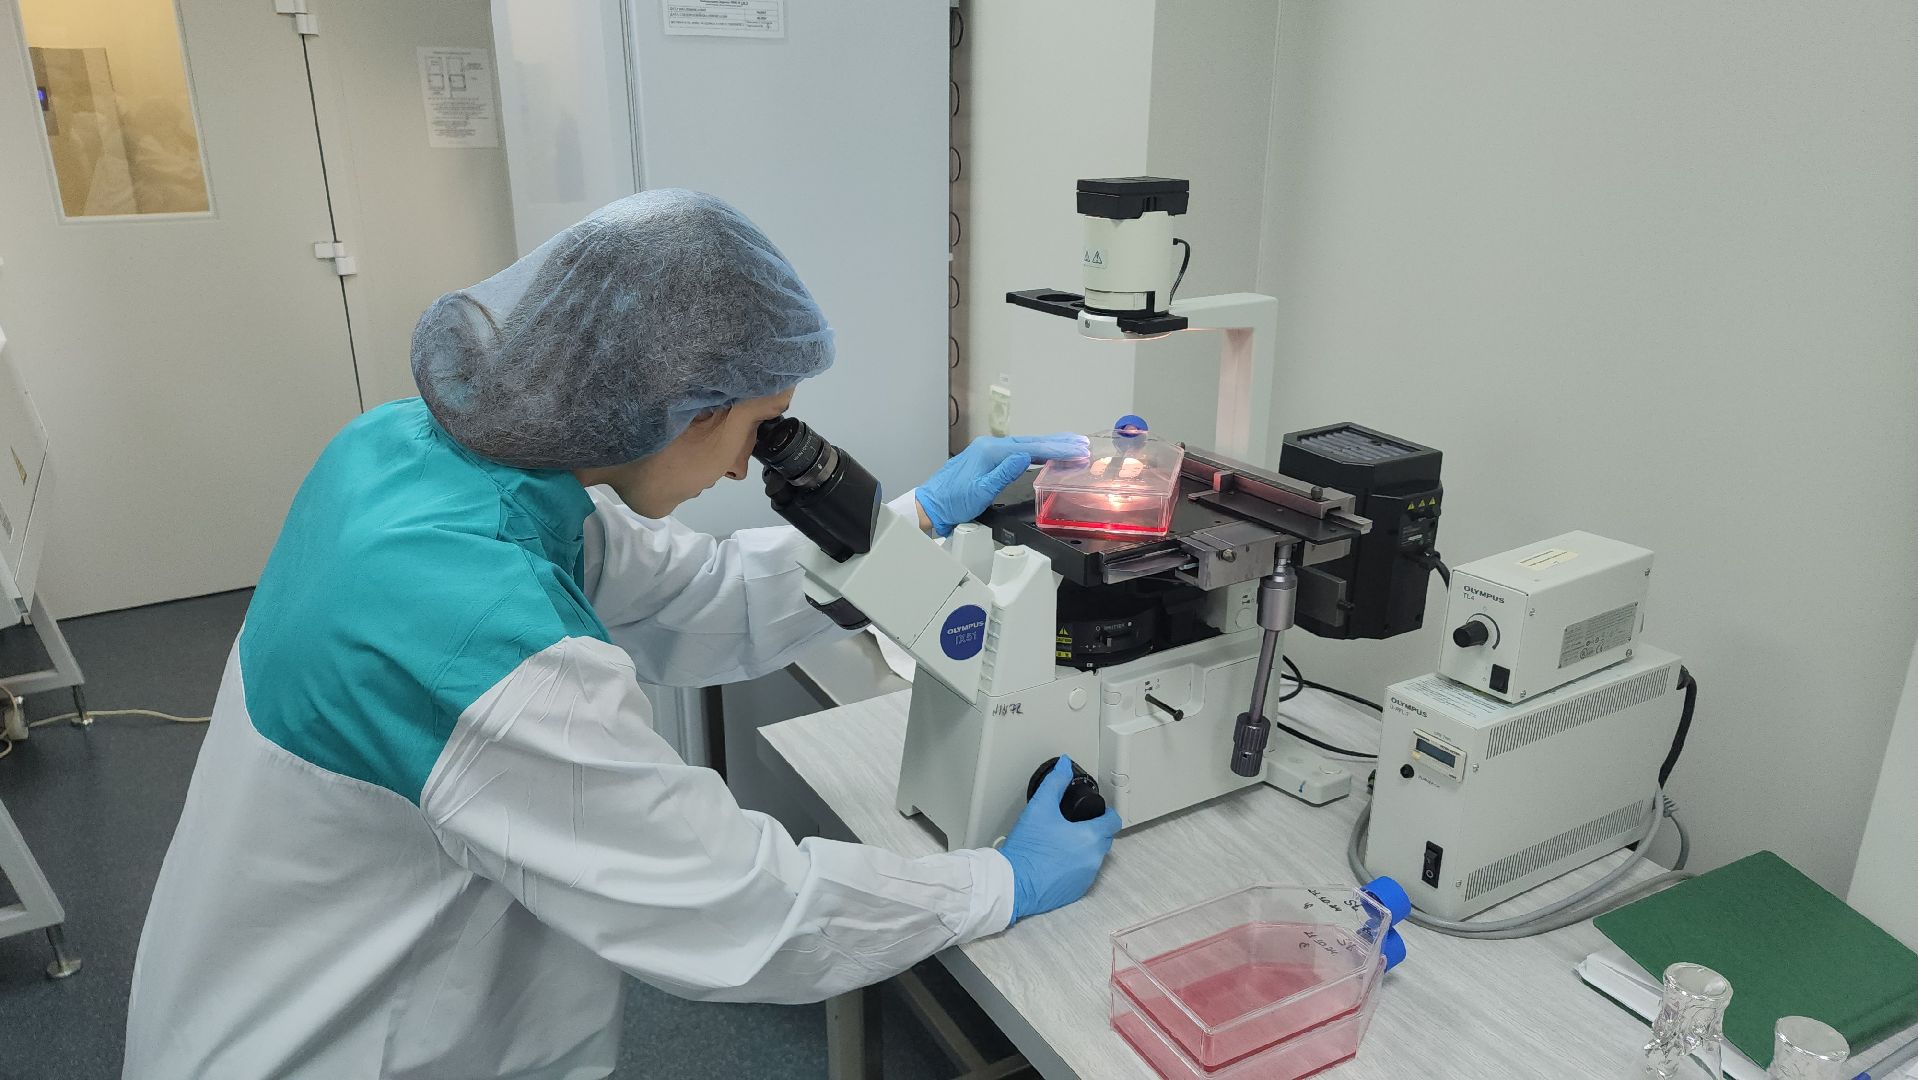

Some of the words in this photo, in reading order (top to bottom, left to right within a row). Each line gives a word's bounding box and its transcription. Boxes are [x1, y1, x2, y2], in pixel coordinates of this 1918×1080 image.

[1463, 585, 1505, 604] OLYMPUS
[947, 621, 984, 634] OLYMPUS
[955, 631, 977, 645] IX51
[1390, 697, 1428, 718] OLYMPUS
